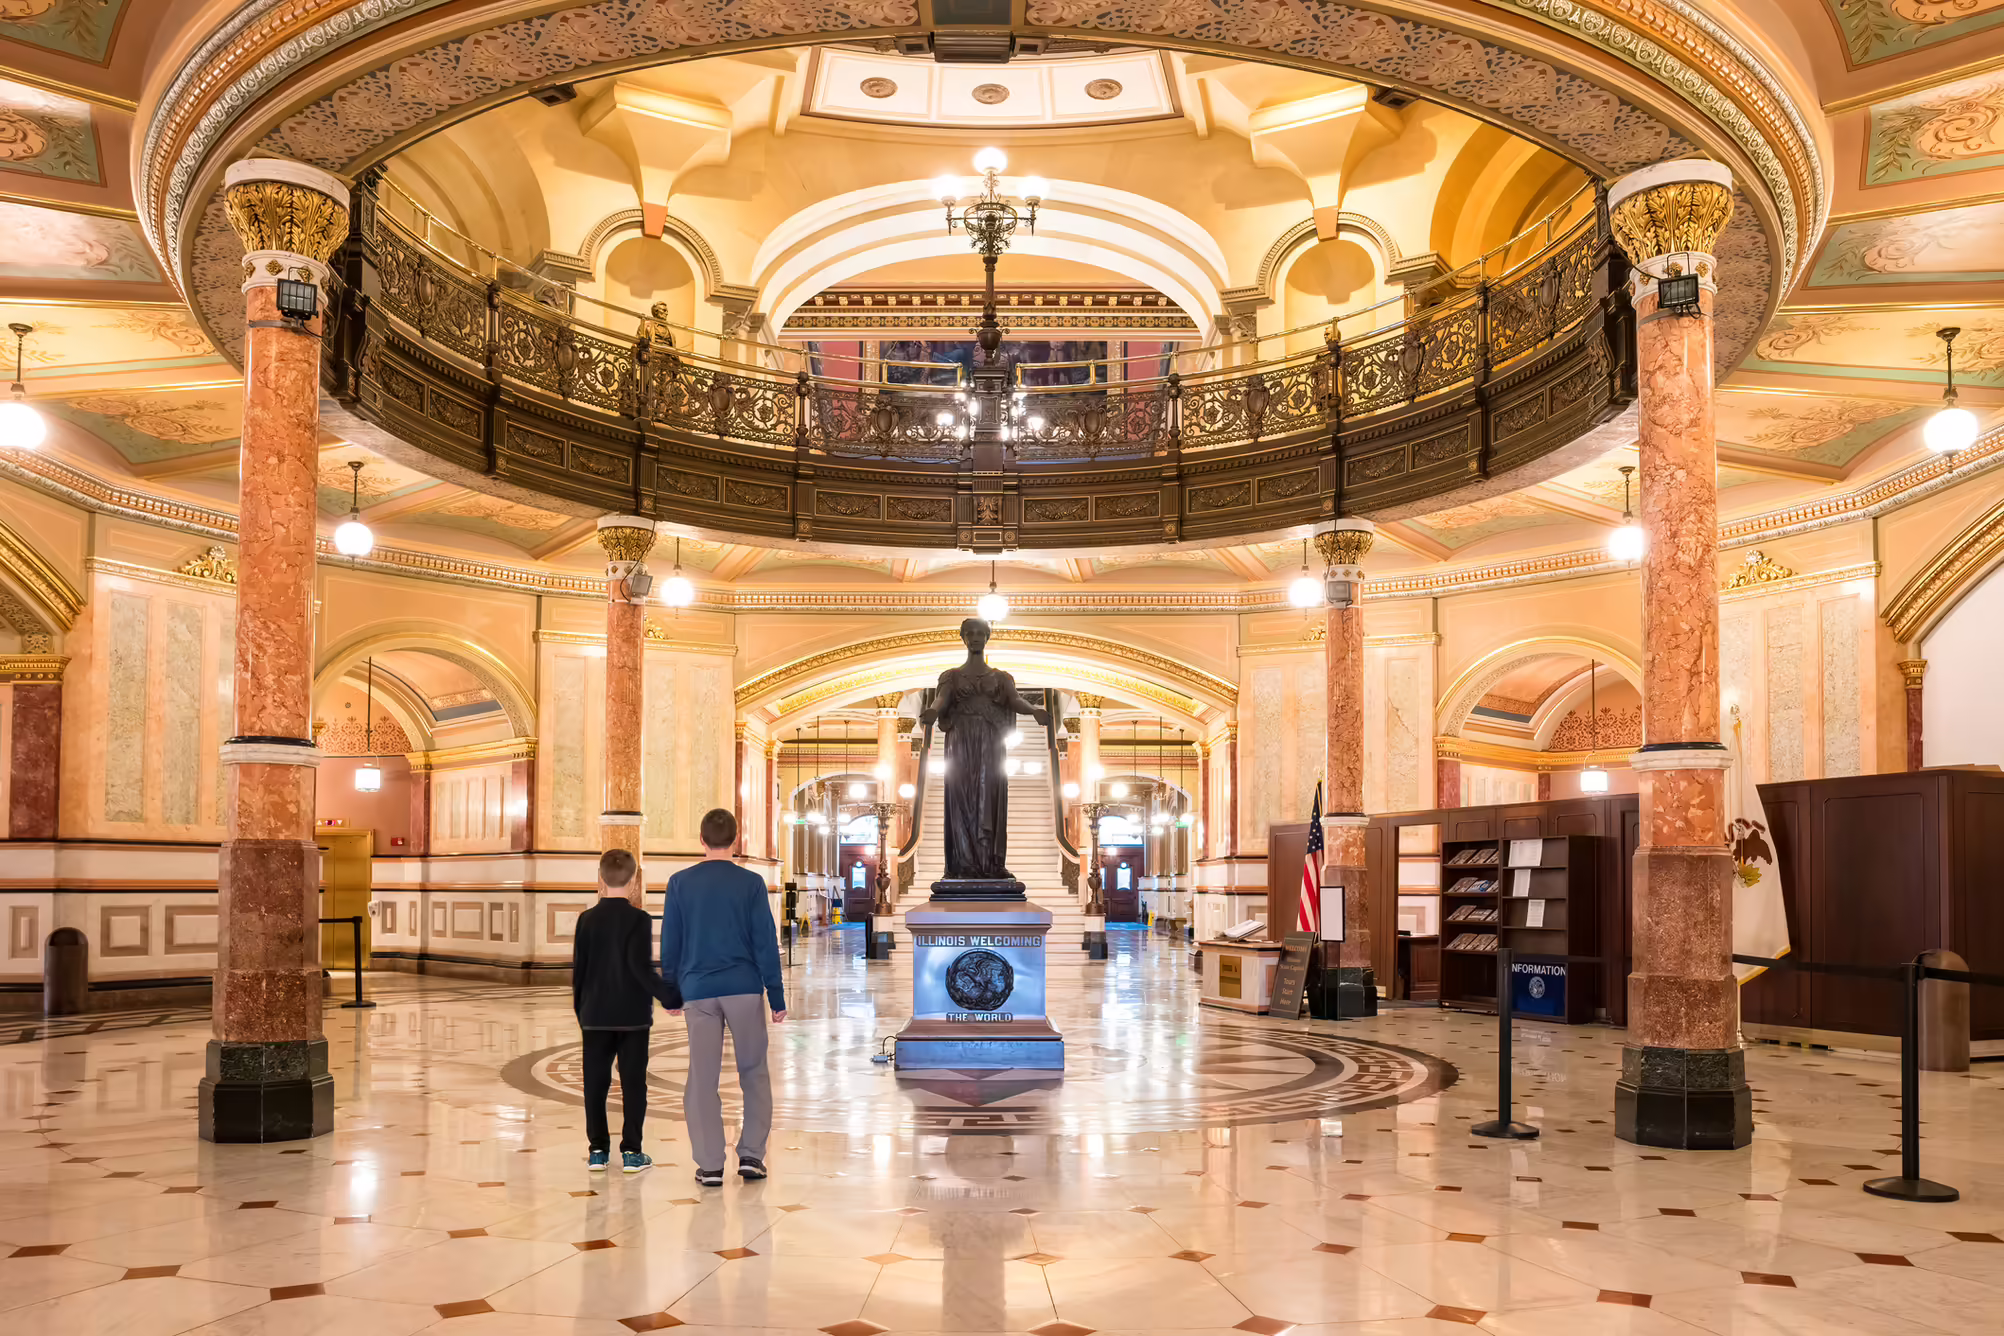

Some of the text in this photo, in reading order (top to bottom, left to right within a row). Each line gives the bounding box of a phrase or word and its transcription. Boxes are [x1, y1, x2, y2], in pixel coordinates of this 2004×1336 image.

[917, 935, 1041, 946] ILLINOIS WELCOMING
[1512, 963, 1566, 976] NFORMATION
[948, 1013, 1012, 1022] THE WORLD
